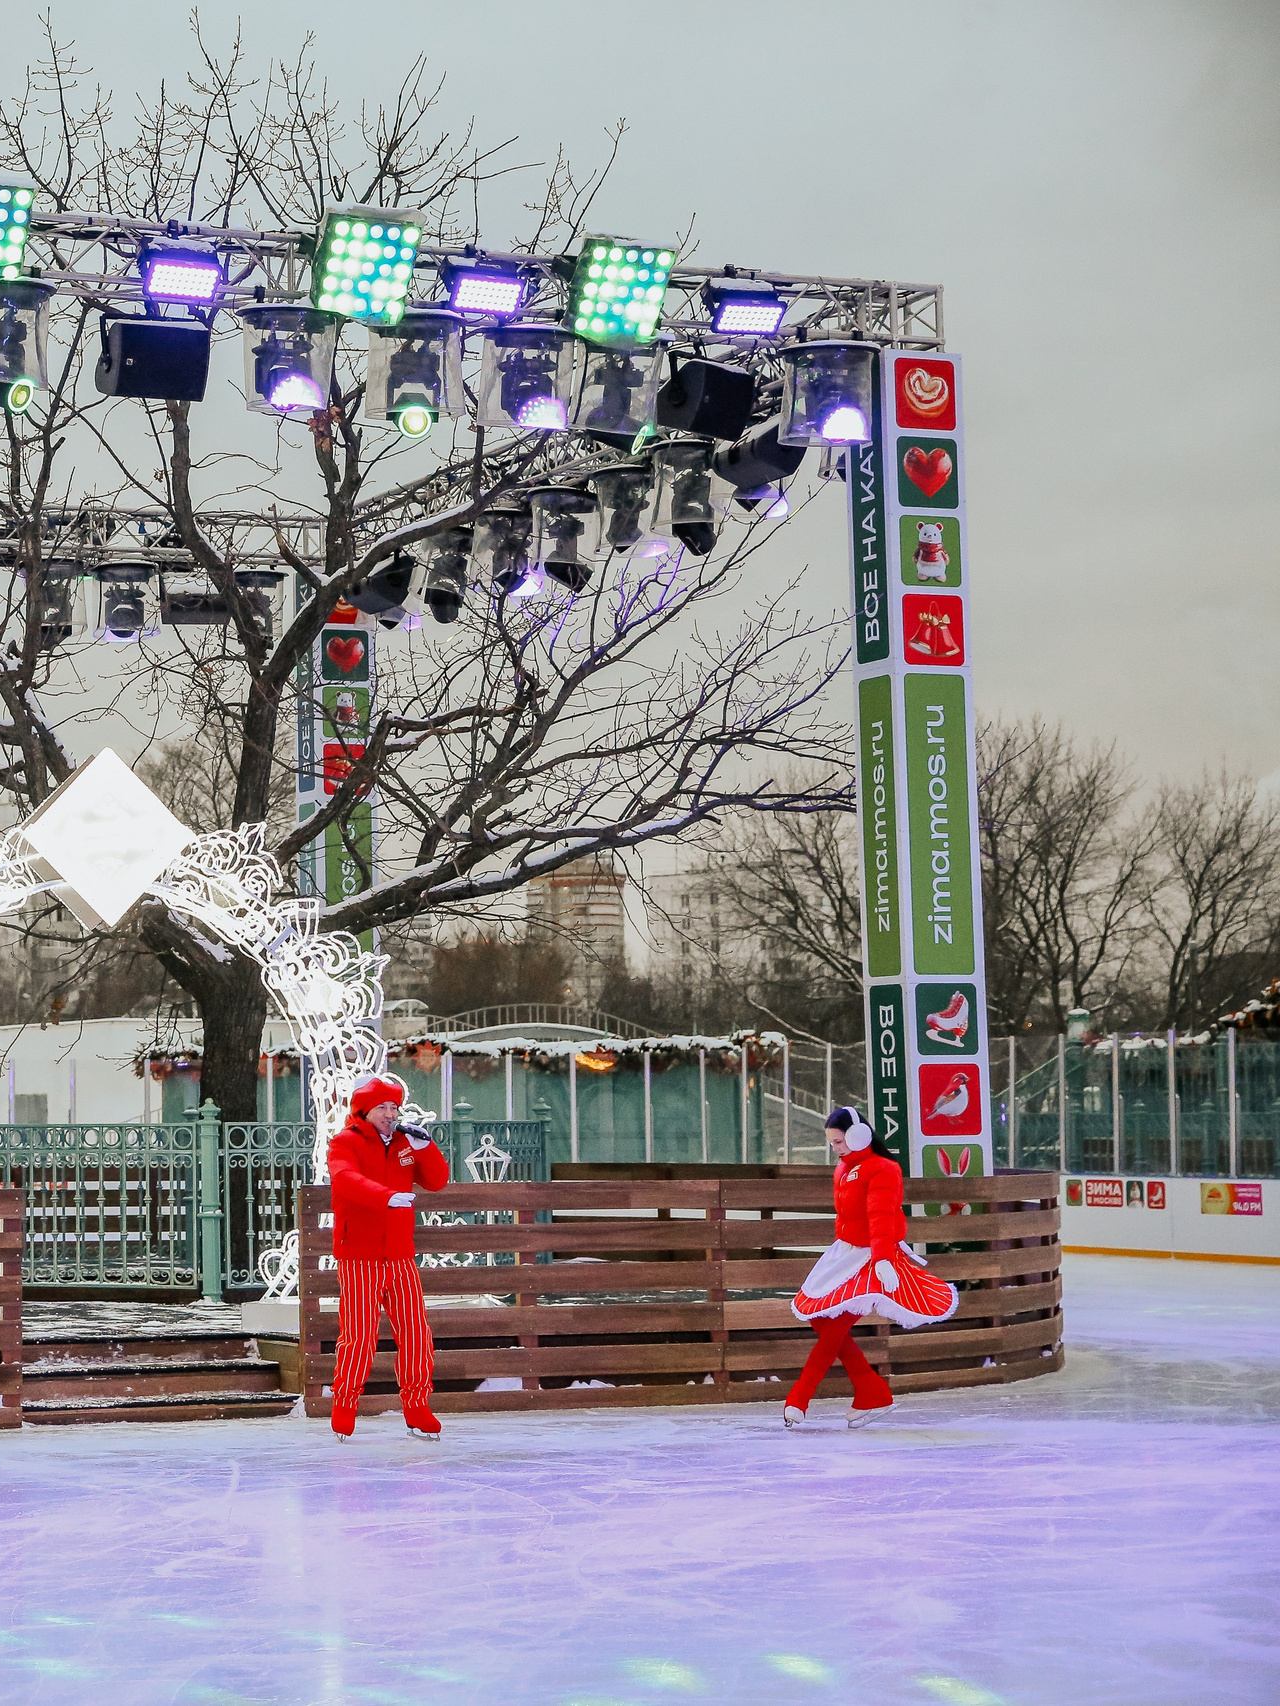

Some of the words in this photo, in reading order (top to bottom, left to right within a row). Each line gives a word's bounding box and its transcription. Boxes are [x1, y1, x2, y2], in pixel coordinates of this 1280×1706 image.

[861, 508, 878, 561] НА
[863, 569, 880, 643] ВСЕ
[870, 720, 890, 933] zima.mos.ru
[925, 704, 953, 945] zima.mos.ru
[879, 1004, 897, 1078] ВСЕ
[882, 1087, 900, 1140] НА
[1086, 1182, 1122, 1196] ЗИМА
